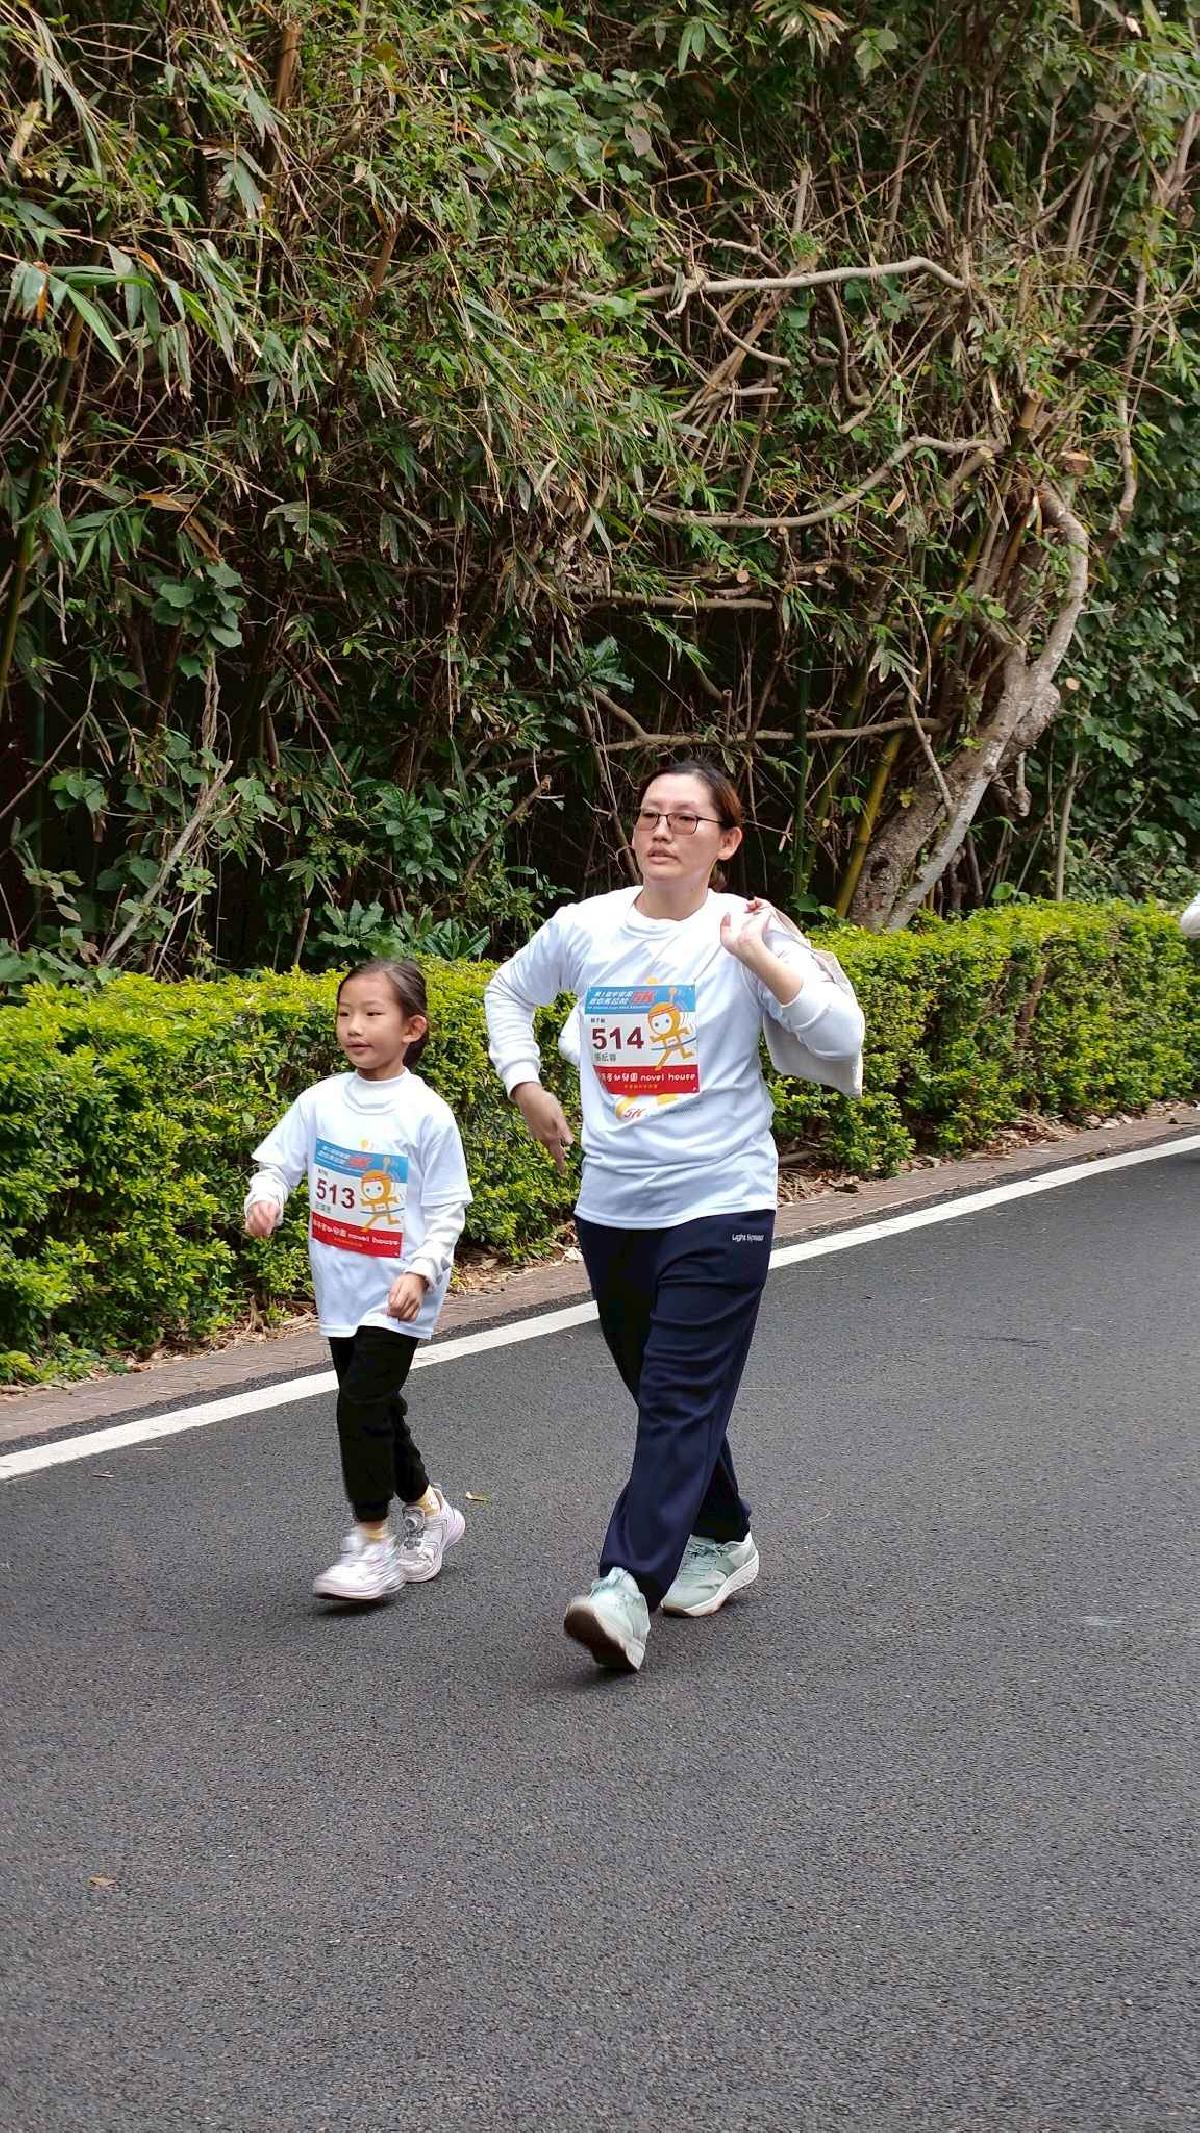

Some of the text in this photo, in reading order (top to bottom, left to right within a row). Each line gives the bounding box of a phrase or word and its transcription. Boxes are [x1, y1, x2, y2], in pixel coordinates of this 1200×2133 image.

[592, 1026, 644, 1049] 514
[640, 1073, 665, 1081] novel
[668, 1072, 696, 1081] house
[316, 1178, 355, 1209] 513
